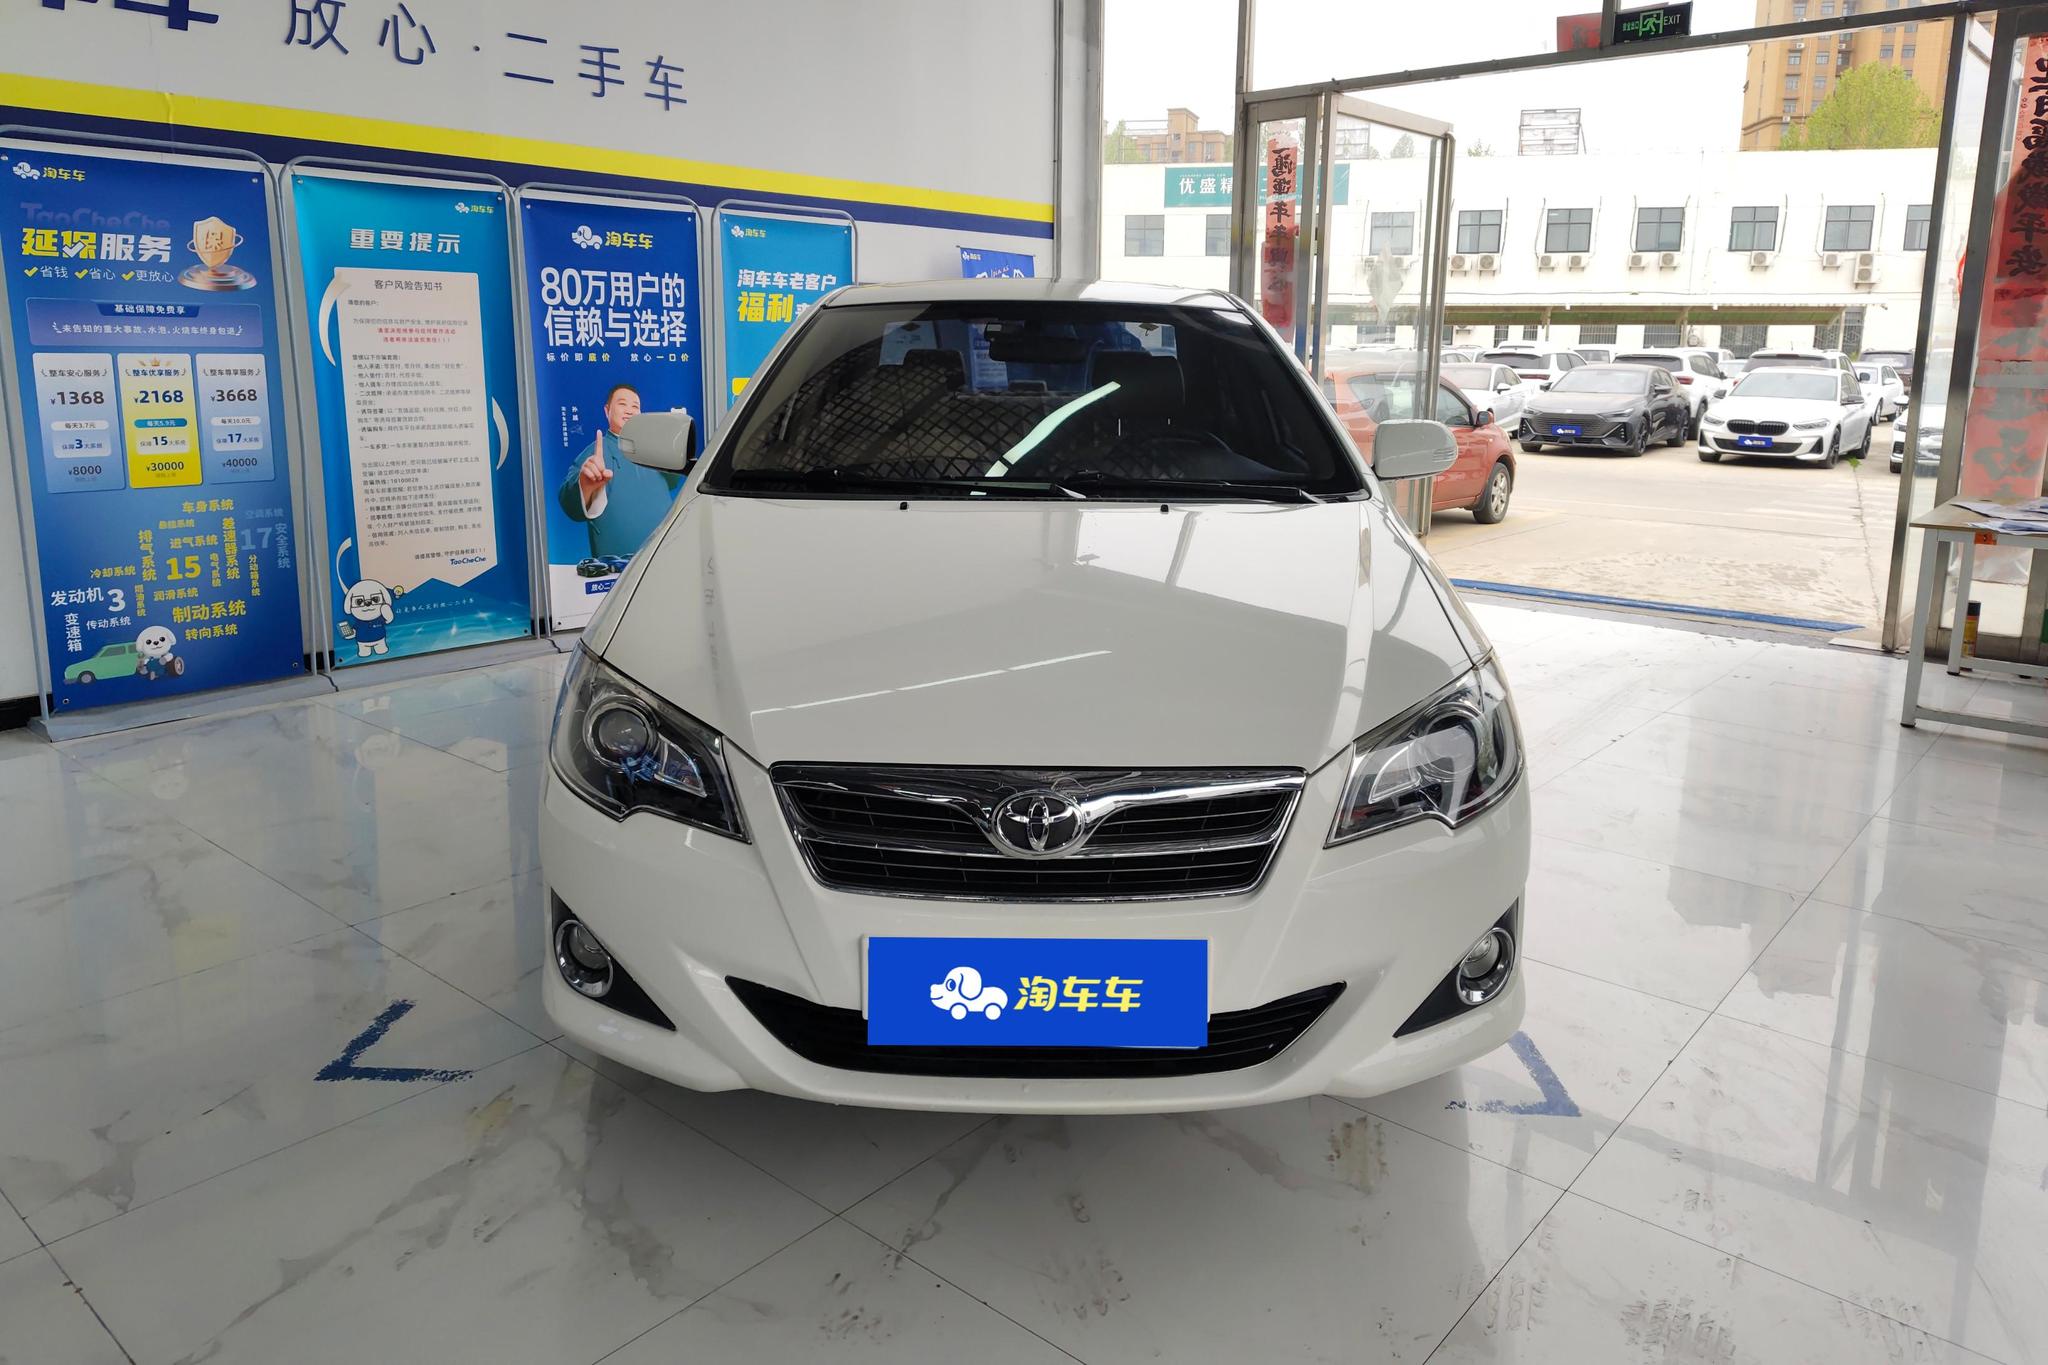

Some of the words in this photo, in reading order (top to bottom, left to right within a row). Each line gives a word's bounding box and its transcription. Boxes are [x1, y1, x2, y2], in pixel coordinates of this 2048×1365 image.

[1664, 14, 1681, 26] EXIT
[42, 166, 86, 181] 淘车车
[21, 228, 171, 263] 延保服务
[350, 228, 461, 254] 重要提示
[604, 231, 654, 249] 淘车车
[40, 265, 69, 279] 省钱
[90, 267, 116, 280] 省心
[136, 270, 174, 283] 更放心
[737, 269, 837, 291] 淘车车老客户
[374, 280, 443, 292] 客户风险告知书
[540, 266, 685, 308] 80万用户的
[114, 303, 185, 315] 基础保障免费享
[543, 307, 688, 348] 信赖与选择
[546, 352, 611, 362] 标价即底价
[630, 353, 689, 362] 放心一口价
[48, 369, 101, 378] 整车安心服务
[132, 368, 180, 377] 整车优享服务
[210, 368, 255, 377] 整车尊享服务
[50, 391, 105, 406] ¥1368
[134, 390, 184, 404] ¥2168
[211, 389, 258, 402] ¥3668
[182, 499, 234, 514] 车身系统
[169, 535, 218, 549] 进气系统
[241, 527, 272, 550] 17
[275, 522, 291, 569] 安全系统
[138, 530, 157, 582] 排气系统
[222, 517, 241, 580] 差速器系统
[90, 565, 136, 579] 冷却系统
[166, 555, 201, 581] 15
[51, 587, 104, 607] 发动机
[107, 588, 126, 612] 3
[153, 587, 198, 601] 润滑系统
[172, 600, 247, 623] 制动系统
[64, 612, 82, 652] 变速箱
[86, 616, 132, 631] 传动系统
[185, 623, 238, 641] 转向系统
